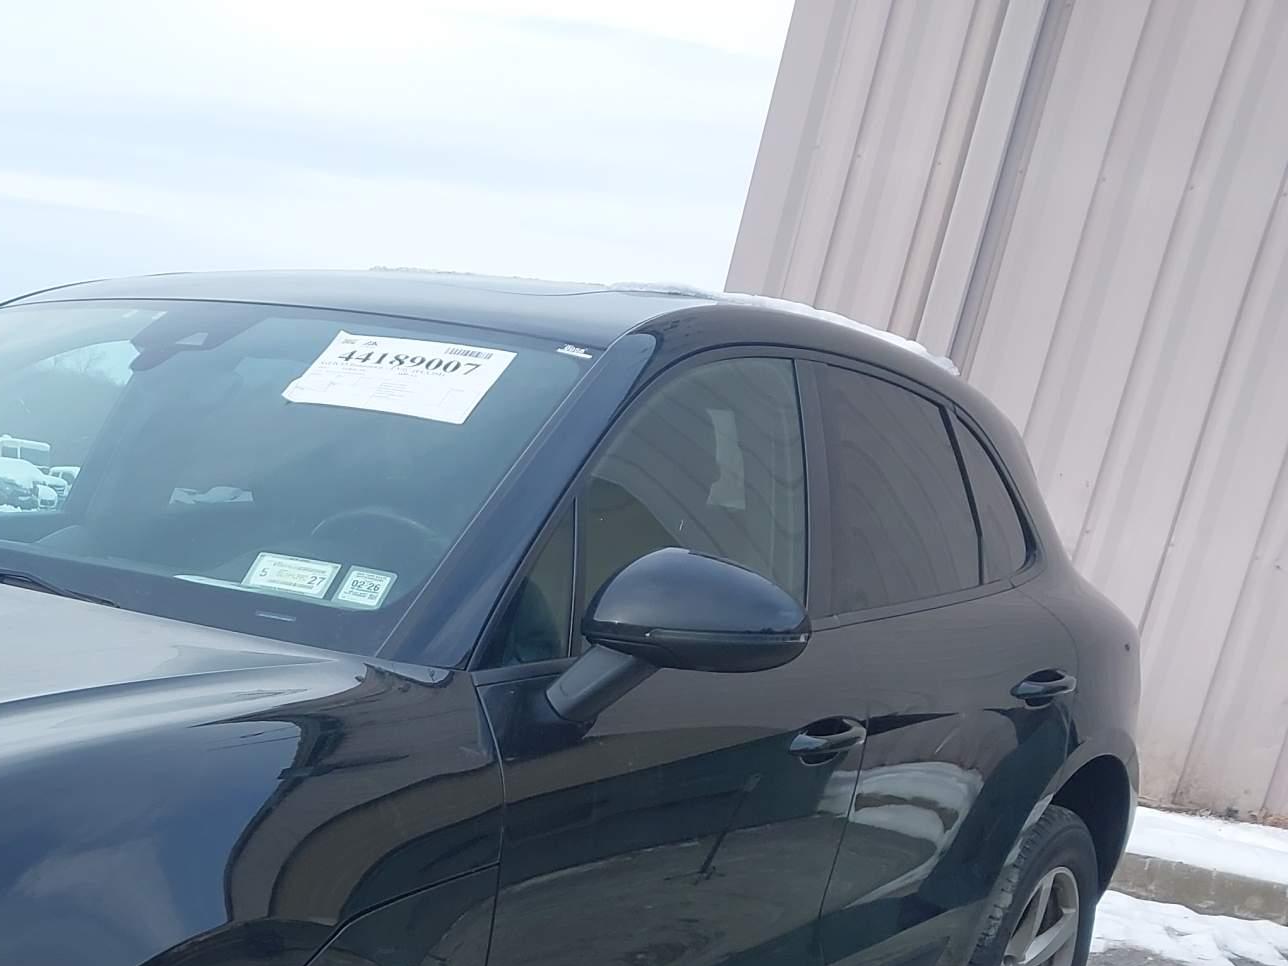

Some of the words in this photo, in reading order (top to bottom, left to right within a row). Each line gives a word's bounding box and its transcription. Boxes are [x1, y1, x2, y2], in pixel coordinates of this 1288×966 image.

[338, 350, 481, 376] 44189007
[259, 567, 269, 577] 5
[307, 576, 326, 586] 27
